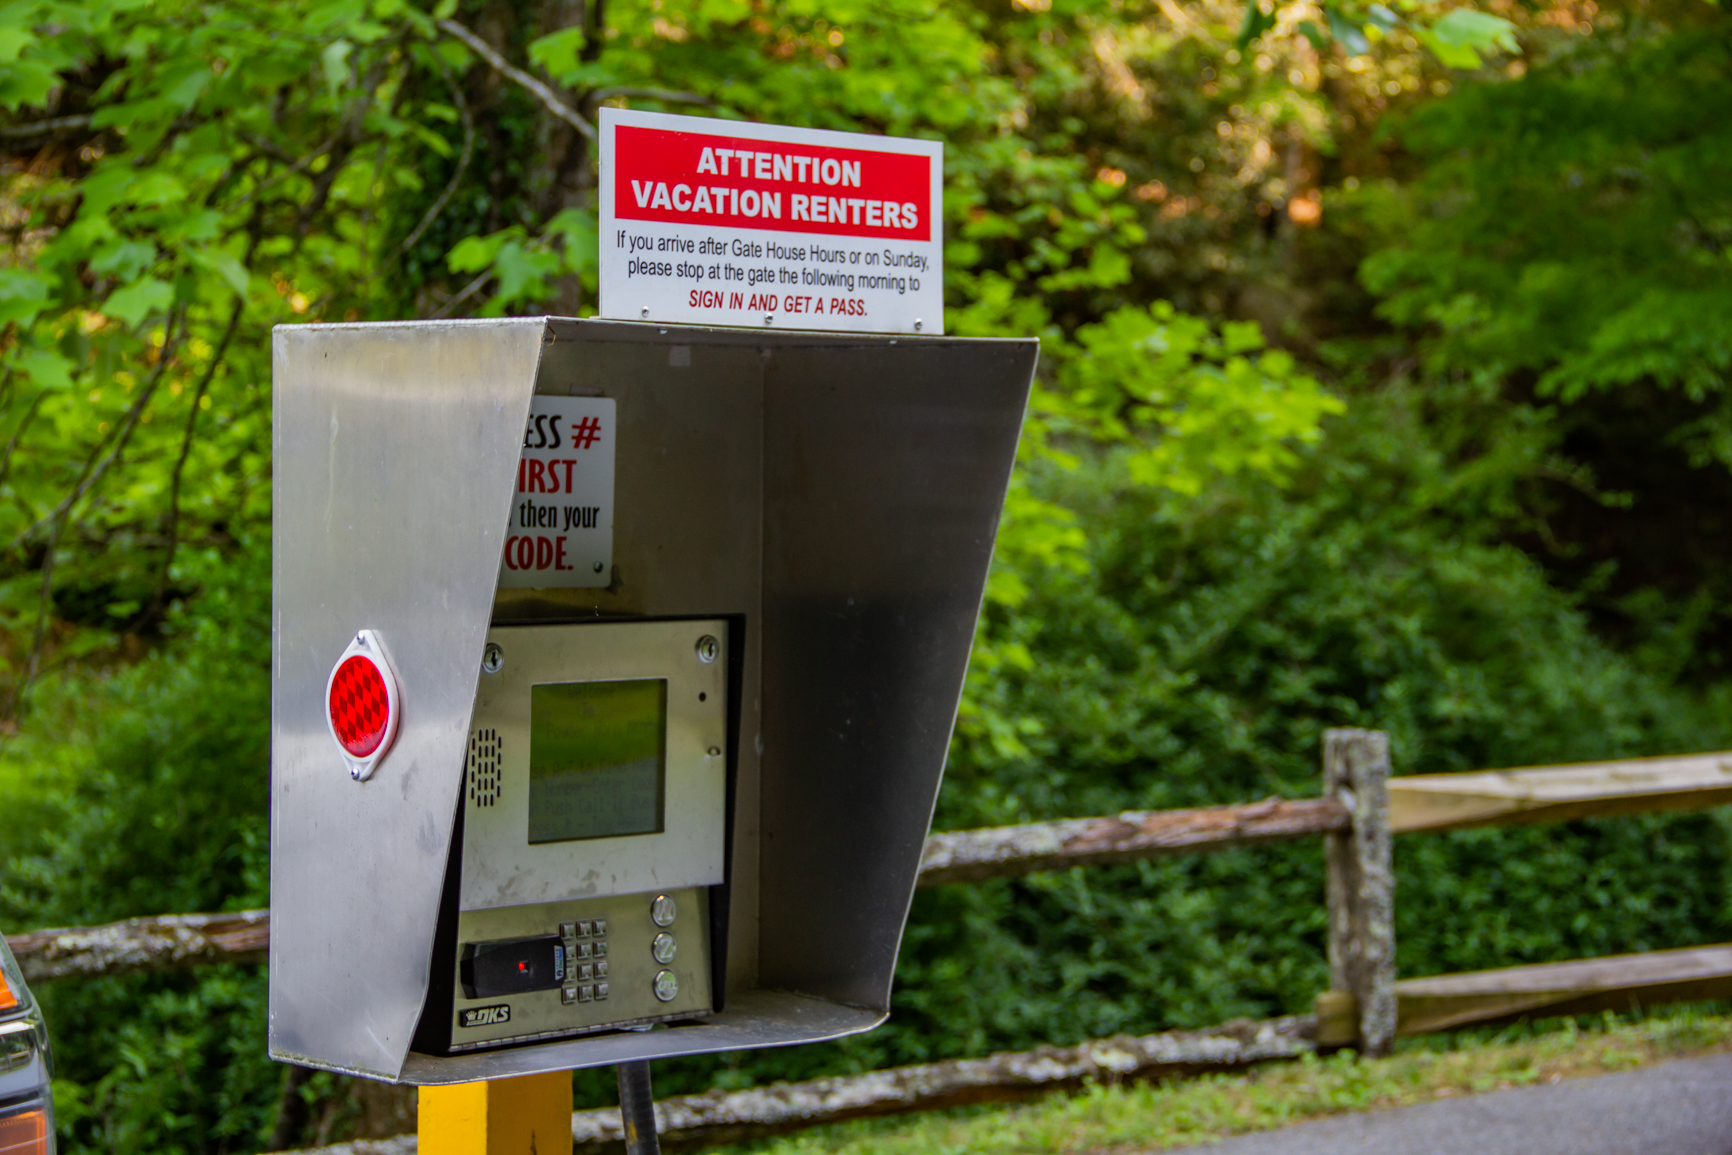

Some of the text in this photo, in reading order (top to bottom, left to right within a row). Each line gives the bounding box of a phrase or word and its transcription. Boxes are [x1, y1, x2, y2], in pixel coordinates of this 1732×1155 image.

[697, 147, 860, 187] ATTENTION
[632, 180, 918, 229] VACATION RENTERS
[617, 230, 929, 272] If you arrive after Gate House Hours or on Sunday,
[628, 257, 920, 295] please stop at the gate the following morning to
[689, 290, 868, 316] SIGN IN AND GET A PASS.
[571, 416, 601, 449] #
[520, 499, 600, 532] then your
[504, 535, 574, 570] CODE.
